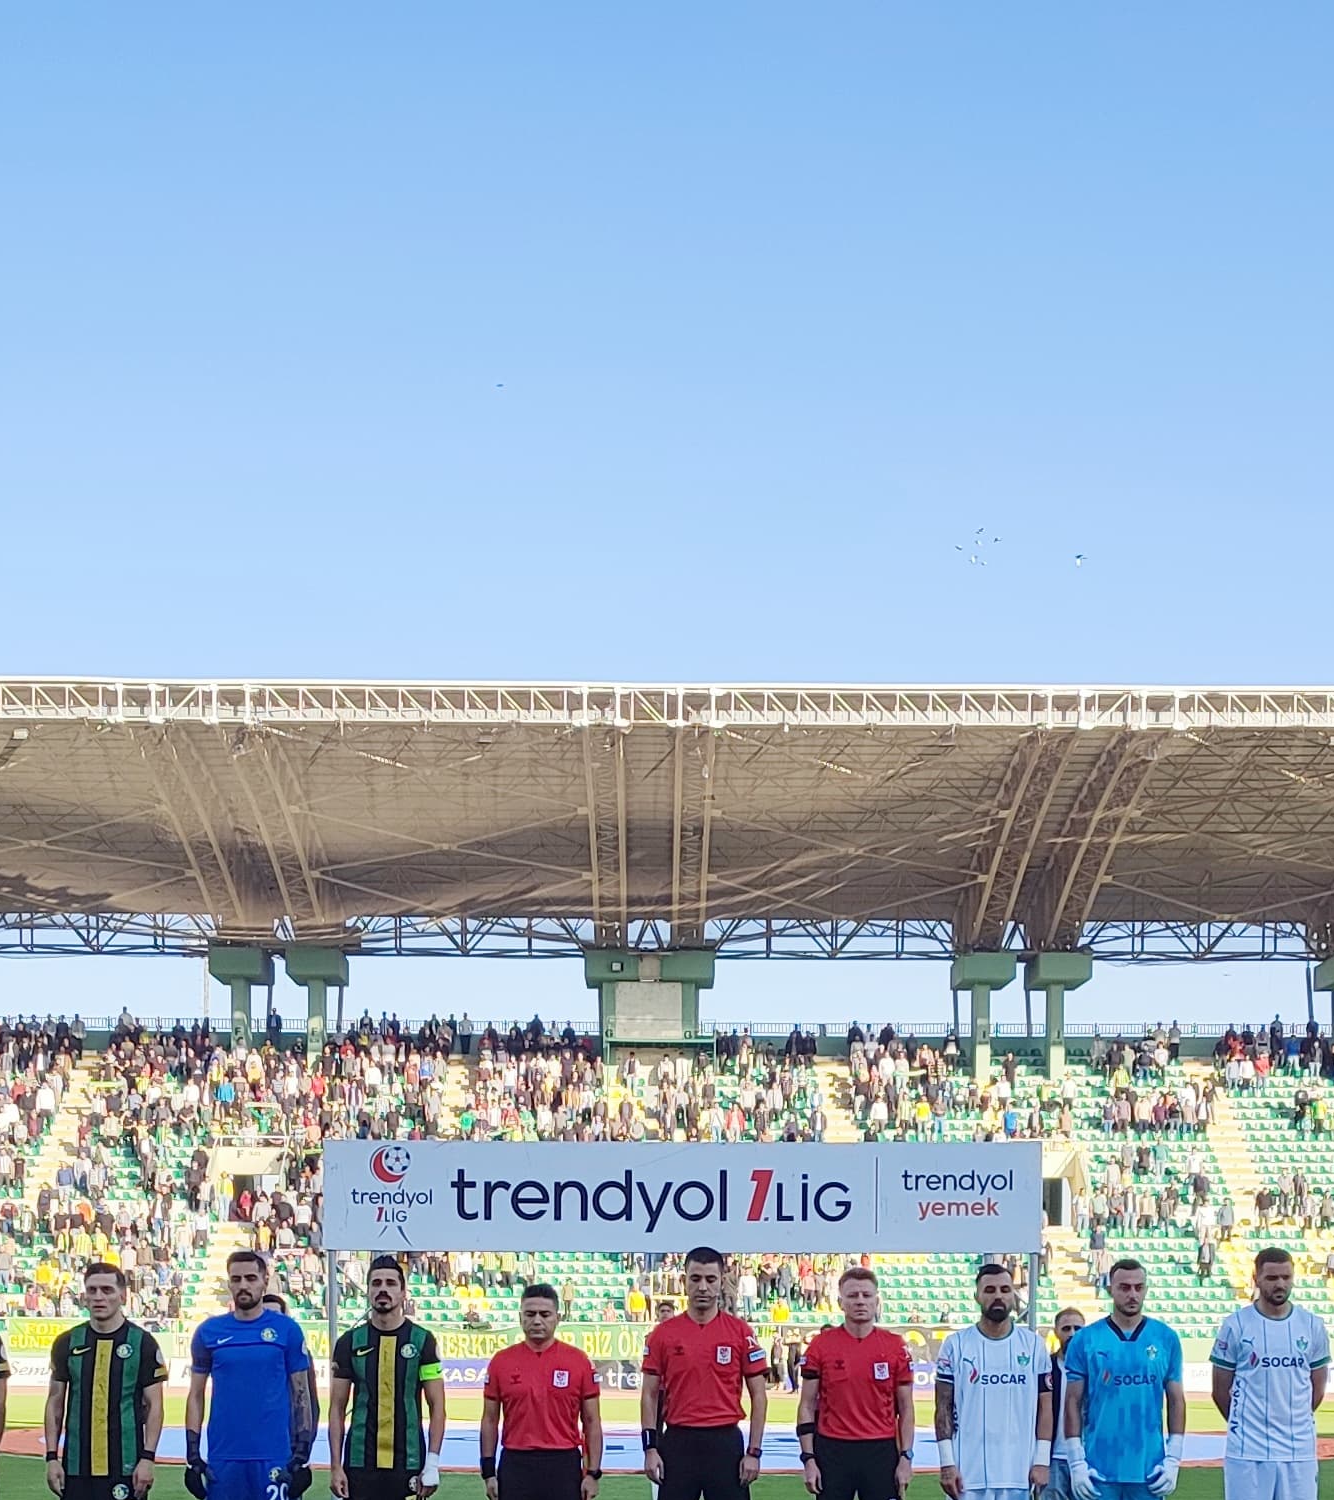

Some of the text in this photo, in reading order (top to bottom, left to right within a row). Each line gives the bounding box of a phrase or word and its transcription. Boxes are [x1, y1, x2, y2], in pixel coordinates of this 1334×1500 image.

[902, 1169, 1014, 1194] trendyol
[351, 1188, 432, 1208] trendyol
[451, 1169, 728, 1233] trendyol
[917, 1197, 1000, 1220] yemek
[606, 1366, 641, 1388] tre
[981, 1373, 1027, 1386] SOCAR
